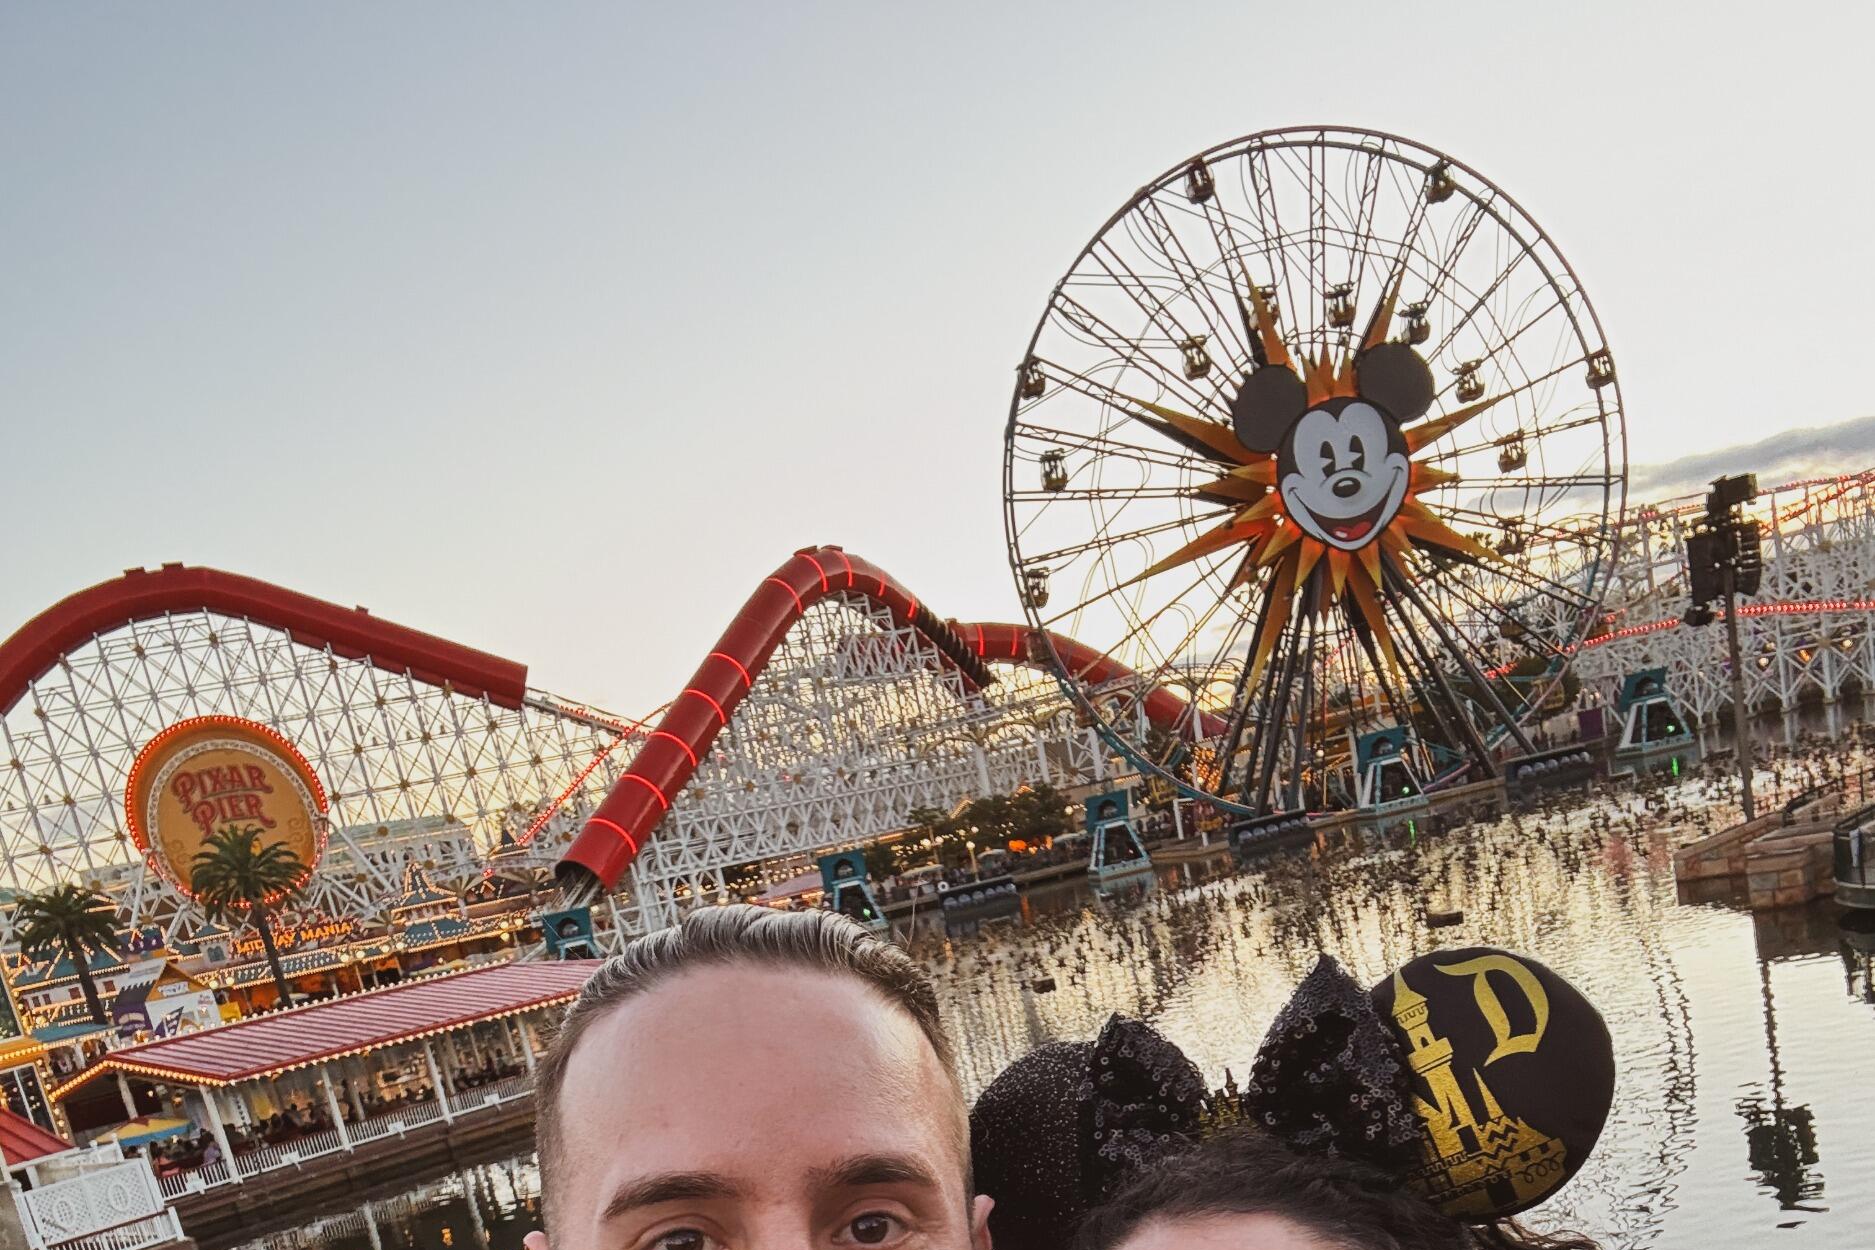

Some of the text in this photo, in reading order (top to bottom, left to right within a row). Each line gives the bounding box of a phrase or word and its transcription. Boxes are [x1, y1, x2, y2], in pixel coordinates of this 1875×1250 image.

[171, 764, 273, 813] PIXAR
[193, 793, 276, 837] PIER
[236, 931, 297, 954] MIDAY
[1433, 954, 1549, 1067] D
